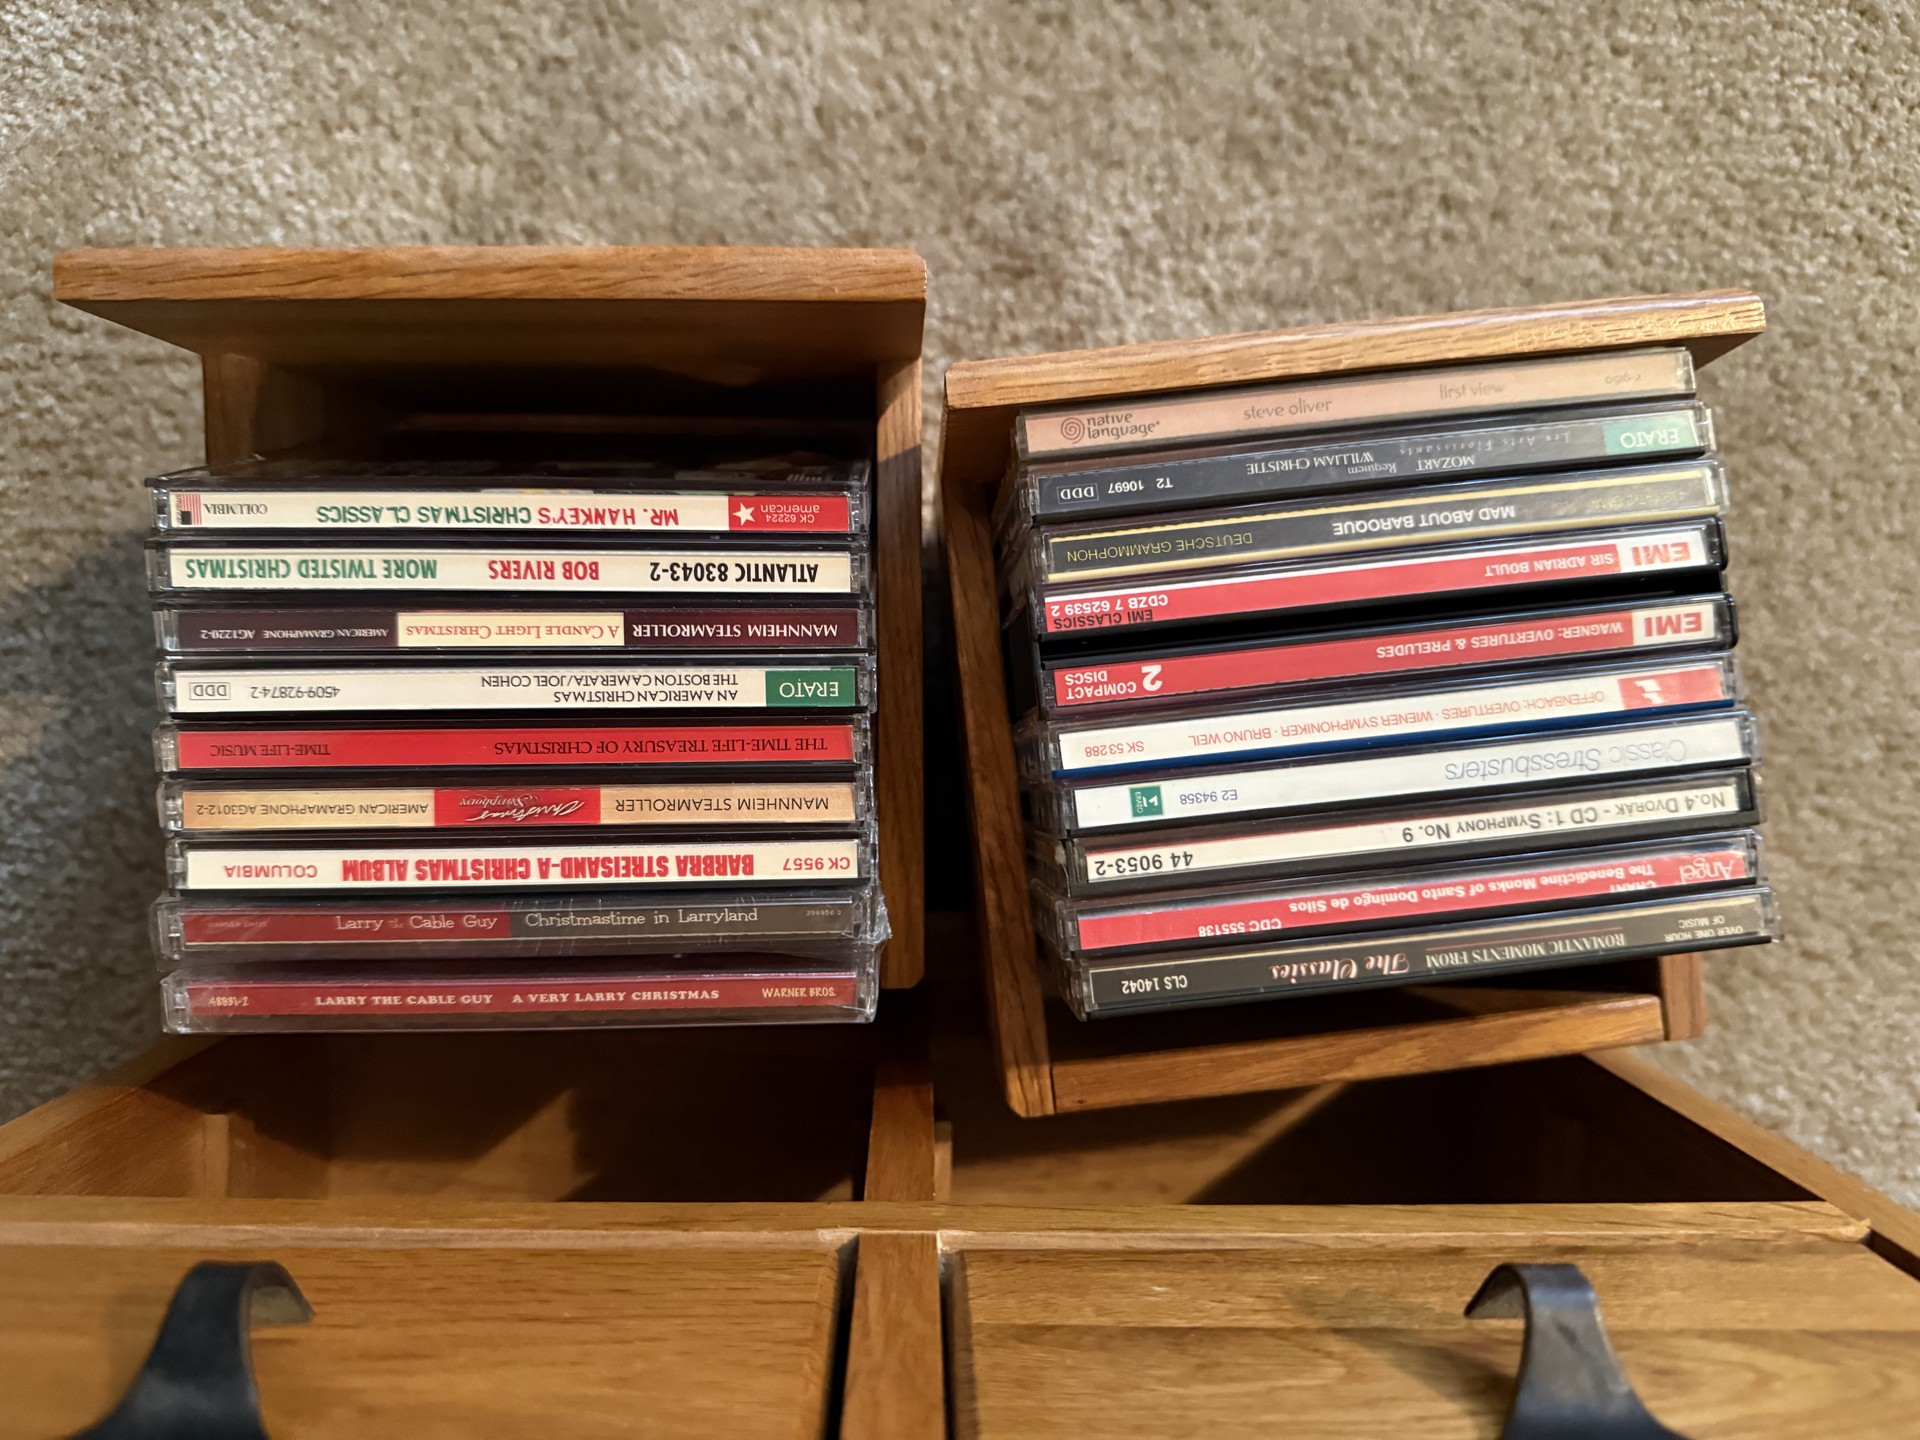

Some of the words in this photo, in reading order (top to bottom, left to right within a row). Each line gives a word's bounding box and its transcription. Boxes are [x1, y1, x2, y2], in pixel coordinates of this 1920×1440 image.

[1438, 382, 1467, 399] first
[1469, 379, 1504, 396] view
[1242, 401, 1284, 420] steve
[1288, 394, 1332, 416] oliver
[1086, 411, 1133, 427] native
[1619, 427, 1678, 448] ERATO
[1246, 457, 1309, 474] CHRISTIE
[1312, 451, 1373, 468] WILLIAM
[1415, 455, 1475, 470] MOZART
[1347, 461, 1396, 476] Requiem
[1107, 479, 1144, 494] 10697
[1155, 476, 1172, 489] T2
[1059, 484, 1094, 500] DDD
[203, 503, 267, 514] COLUMBIA
[317, 506, 410, 522] CLASSICS
[417, 505, 531, 523] CHRISTMAS
[538, 507, 634, 524] HANKEY'S
[760, 504, 819, 517] american
[1478, 504, 1514, 520] MAD
[643, 508, 678, 525] MR.
[765, 513, 795, 522] 62224
[798, 513, 814, 522] CK
[1419, 508, 1474, 526] ABOUT
[1332, 514, 1414, 535] BAROQUE
[1175, 532, 1252, 550] DEUTSCHE
[1066, 540, 1171, 561] GRAMMOPHON
[1589, 551, 1613, 565] SIR
[1630, 541, 1690, 565] EMI
[185, 559, 290, 577] CHRISTMAS
[297, 559, 376, 578] TWISTED
[382, 559, 437, 578] MORE
[487, 559, 554, 579] RIVERS
[562, 560, 599, 579] BOB
[1483, 560, 1529, 577] BOULT
[1531, 554, 1585, 571] ADRIAN
[649, 562, 728, 581] 83043-2
[735, 562, 818, 581] ATLANTIC
[1064, 599, 1110, 615] 62539
[1114, 598, 1123, 610] 7
[1127, 593, 1168, 608] CDZB
[1050, 604, 1059, 616] 2
[1127, 608, 1153, 622] EMI
[1053, 612, 1121, 629] CLASSICS
[1643, 612, 1703, 637] EMI
[263, 629, 334, 638] GRAMAPHONE
[335, 628, 388, 636] AMERICAN
[405, 625, 491, 638] CHRISTMAS
[495, 625, 540, 638] LIGHT
[544, 625, 603, 638] CANDLE
[607, 625, 618, 638] A
[632, 624, 740, 637] STEAMROLLER
[747, 623, 837, 637] MANNHEIM
[1557, 621, 1622, 639] WAGNER:
[1454, 637, 1466, 650] &
[1470, 628, 1553, 648] OVERTURES
[1375, 639, 1451, 658] PRELUDES
[481, 675, 531, 687] COHEN
[654, 673, 711, 685] BOSTON
[713, 673, 737, 685] THE
[1064, 669, 1107, 685] DISCS
[1140, 663, 1162, 691] 2
[193, 684, 226, 695] DDD
[250, 686, 340, 697] 4509-92874-2
[716, 689, 737, 700] AN
[779, 678, 838, 696] ERATO
[1066, 680, 1136, 699] COMPACT
[553, 690, 634, 702] CHRISTMAS
[636, 690, 713, 701] AMERICAN
[1523, 690, 1606, 710] OFFENBACH:
[1441, 699, 1520, 719] OVERTURES
[1380, 709, 1431, 725] WIENER
[1280, 715, 1378, 736] SYMPHONIKER
[1188, 732, 1220, 746] WEIL
[1223, 726, 1270, 743] BRUNO
[210, 744, 256, 755] MUSIC
[260, 743, 330, 754] TIME-LIFE
[494, 741, 592, 754] CHRISTMAS
[596, 740, 618, 753] OF
[622, 739, 708, 752] TREASURY
[712, 738, 790, 751] TIME-LIFE
[794, 737, 827, 749] THE
[1126, 740, 1144, 753] SK
[1608, 738, 1686, 768] Classic
[1444, 747, 1601, 784] Stressbusters
[459, 793, 541, 808] Symphony
[1179, 790, 1217, 805] 94358
[1220, 788, 1237, 801] E2
[196, 804, 257, 815] AG3012-2
[260, 803, 354, 814] GRAMAPHONE
[359, 802, 427, 813] AMERICAN
[464, 800, 584, 820] Christmas
[615, 798, 731, 811] STEAMROLLER
[737, 797, 828, 809] MANNHEIM
[1546, 810, 1563, 826] 1:
[1570, 806, 1597, 823] CD
[1456, 812, 1540, 835] SYMPHONY
[1401, 826, 1413, 841] 9
[675, 854, 753, 876] BARBRA
[782, 857, 823, 870] 9557
[828, 856, 849, 869] CK
[1094, 853, 1163, 875] 9053-2
[1170, 850, 1193, 867] 44
[223, 864, 317, 877] COLUMBIA
[342, 859, 408, 880] ALBUM
[414, 858, 530, 880] CHRISTMAS
[1539, 866, 1624, 887] Benedictine
[1628, 863, 1654, 877] The
[1678, 854, 1735, 884] Angel
[1468, 882, 1484, 896] of
[1486, 876, 1536, 893] Monks
[1353, 888, 1417, 907] Domingo
[1421, 885, 1465, 900] Santo
[1288, 899, 1327, 914] Silos
[1330, 897, 1348, 910] de
[335, 915, 385, 931] Larry
[409, 915, 455, 930] Cable
[462, 914, 498, 931] Guy
[525, 911, 646, 927] Christmastime
[654, 910, 670, 924] in
[678, 908, 759, 925] Larryland
[1248, 917, 1281, 931] CDC
[1677, 916, 1709, 928] MUSIC
[1710, 914, 1724, 924] OF
[1197, 921, 1245, 936] 555138
[1664, 930, 1692, 942] HOUR
[1693, 927, 1715, 938] ONE
[1716, 924, 1743, 935] OVER
[1547, 932, 1625, 954] ROMANTIC
[1424, 950, 1467, 968] FROM
[1471, 941, 1544, 963] MOMENTS
[1268, 956, 1358, 985] Classics
[1364, 951, 1409, 976] The
[1121, 977, 1159, 993] 14042
[1163, 974, 1187, 989] CLS
[511, 993, 524, 1004] A
[527, 992, 571, 1004] VERY
[574, 991, 628, 1003] LARRY
[631, 988, 720, 1001] CHRISTMAS
[762, 987, 808, 998] WARNER
[809, 986, 837, 997] BROS.
[315, 995, 368, 1007] LARRY
[371, 995, 403, 1007] THE
[406, 994, 457, 1006] CABLE
[461, 994, 494, 1006] GUY
